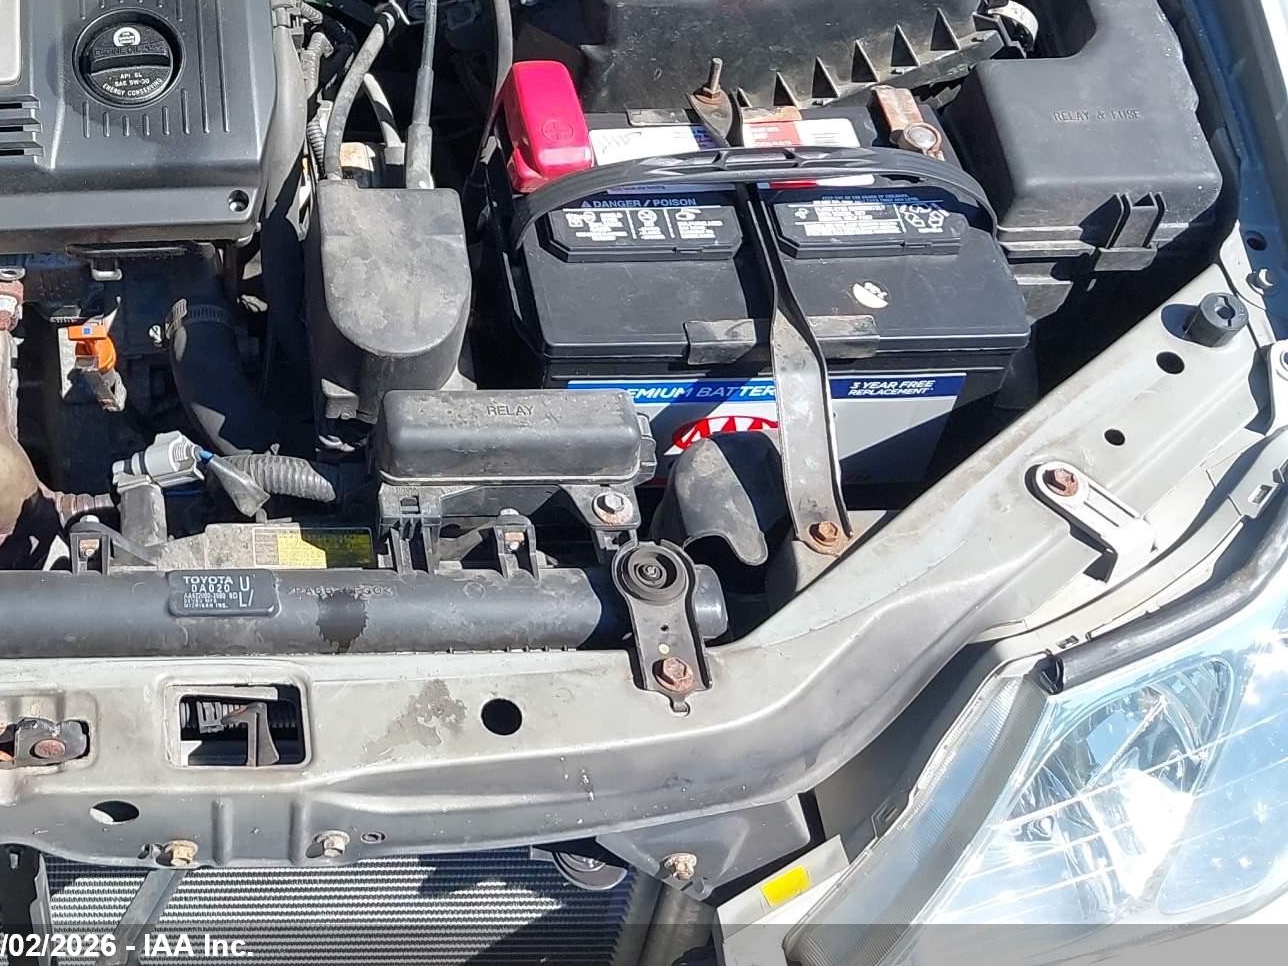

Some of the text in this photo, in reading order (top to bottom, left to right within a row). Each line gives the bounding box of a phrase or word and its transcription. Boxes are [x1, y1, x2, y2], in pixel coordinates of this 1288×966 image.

[102, 82, 125, 96] ENERGY
[593, 199, 641, 208] DANGER
[653, 198, 697, 207] POISON
[849, 379, 936, 389] 3 YEAR FREE
[628, 385, 777, 399] EMIUM BATTER
[486, 405, 534, 416] RELAY
[182, 575, 250, 592] TOYOTA U
[191, 584, 231, 593] 0A020
